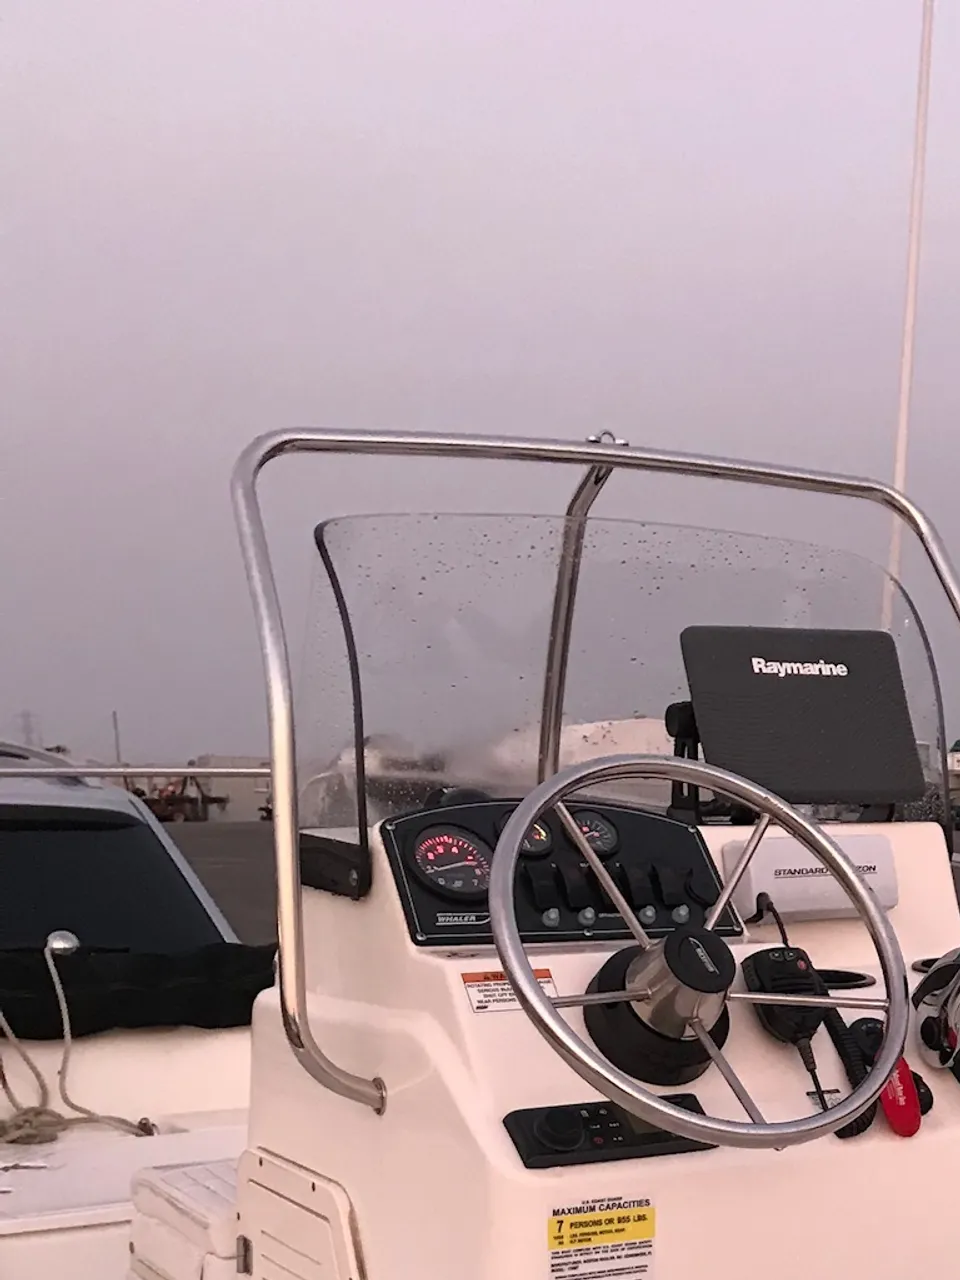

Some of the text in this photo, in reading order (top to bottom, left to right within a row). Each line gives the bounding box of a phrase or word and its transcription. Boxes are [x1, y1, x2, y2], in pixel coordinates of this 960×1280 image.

[751, 657, 849, 678] Raymarine
[774, 866, 829, 876] STANDARD
[437, 915, 477, 923] WHALER
[552, 1199, 651, 1217] MAXIMUM CAPACITIES
[556, 1219, 565, 1233] 7
[569, 1218, 603, 1230] PERSONS
[605, 1217, 615, 1226] OR
